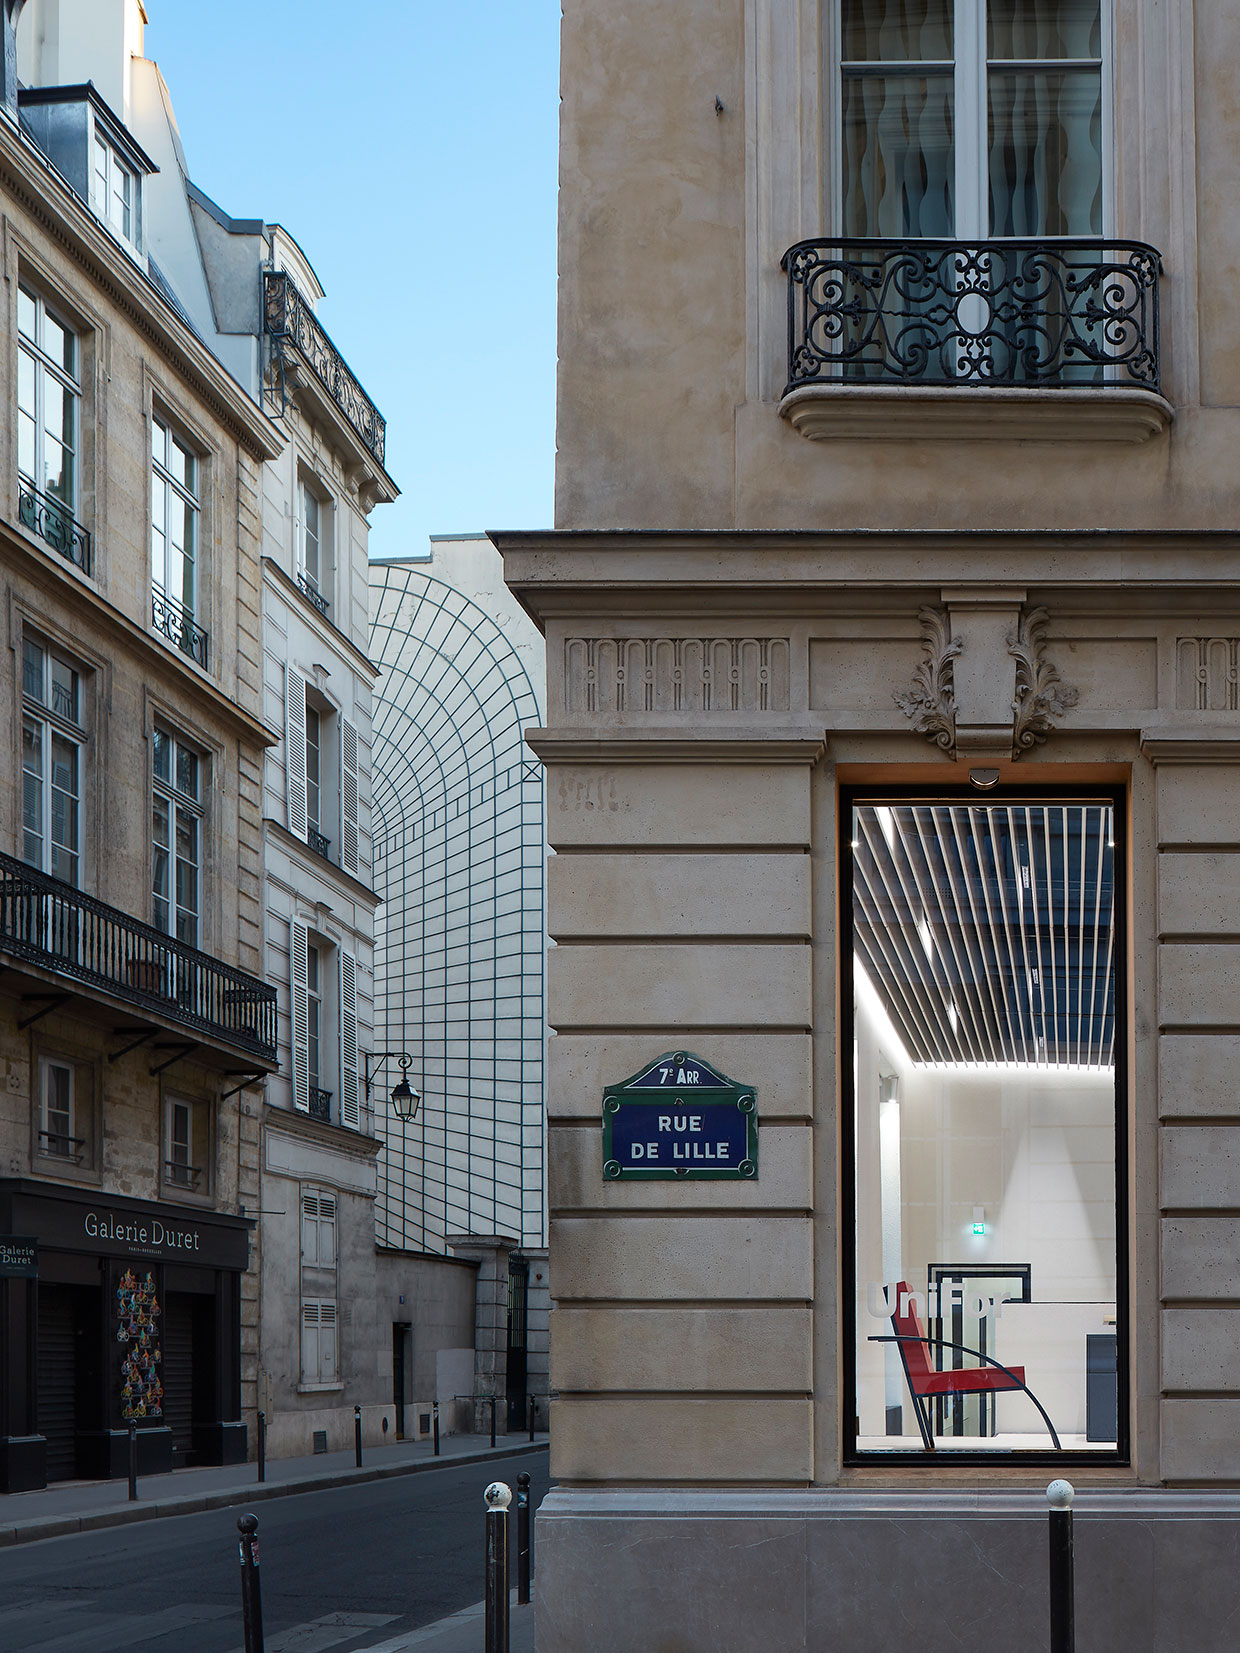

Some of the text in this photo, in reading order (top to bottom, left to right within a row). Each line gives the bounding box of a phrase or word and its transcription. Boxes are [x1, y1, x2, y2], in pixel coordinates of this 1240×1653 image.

[658, 1115, 702, 1132] RUE
[631, 1142, 730, 1159] DE LILLE
[85, 1213, 199, 1250] Galerie Duret
[0, 1245, 35, 1256] Galerie
[2, 1254, 31, 1264] Duret
[867, 1282, 1011, 1319] UniFor
